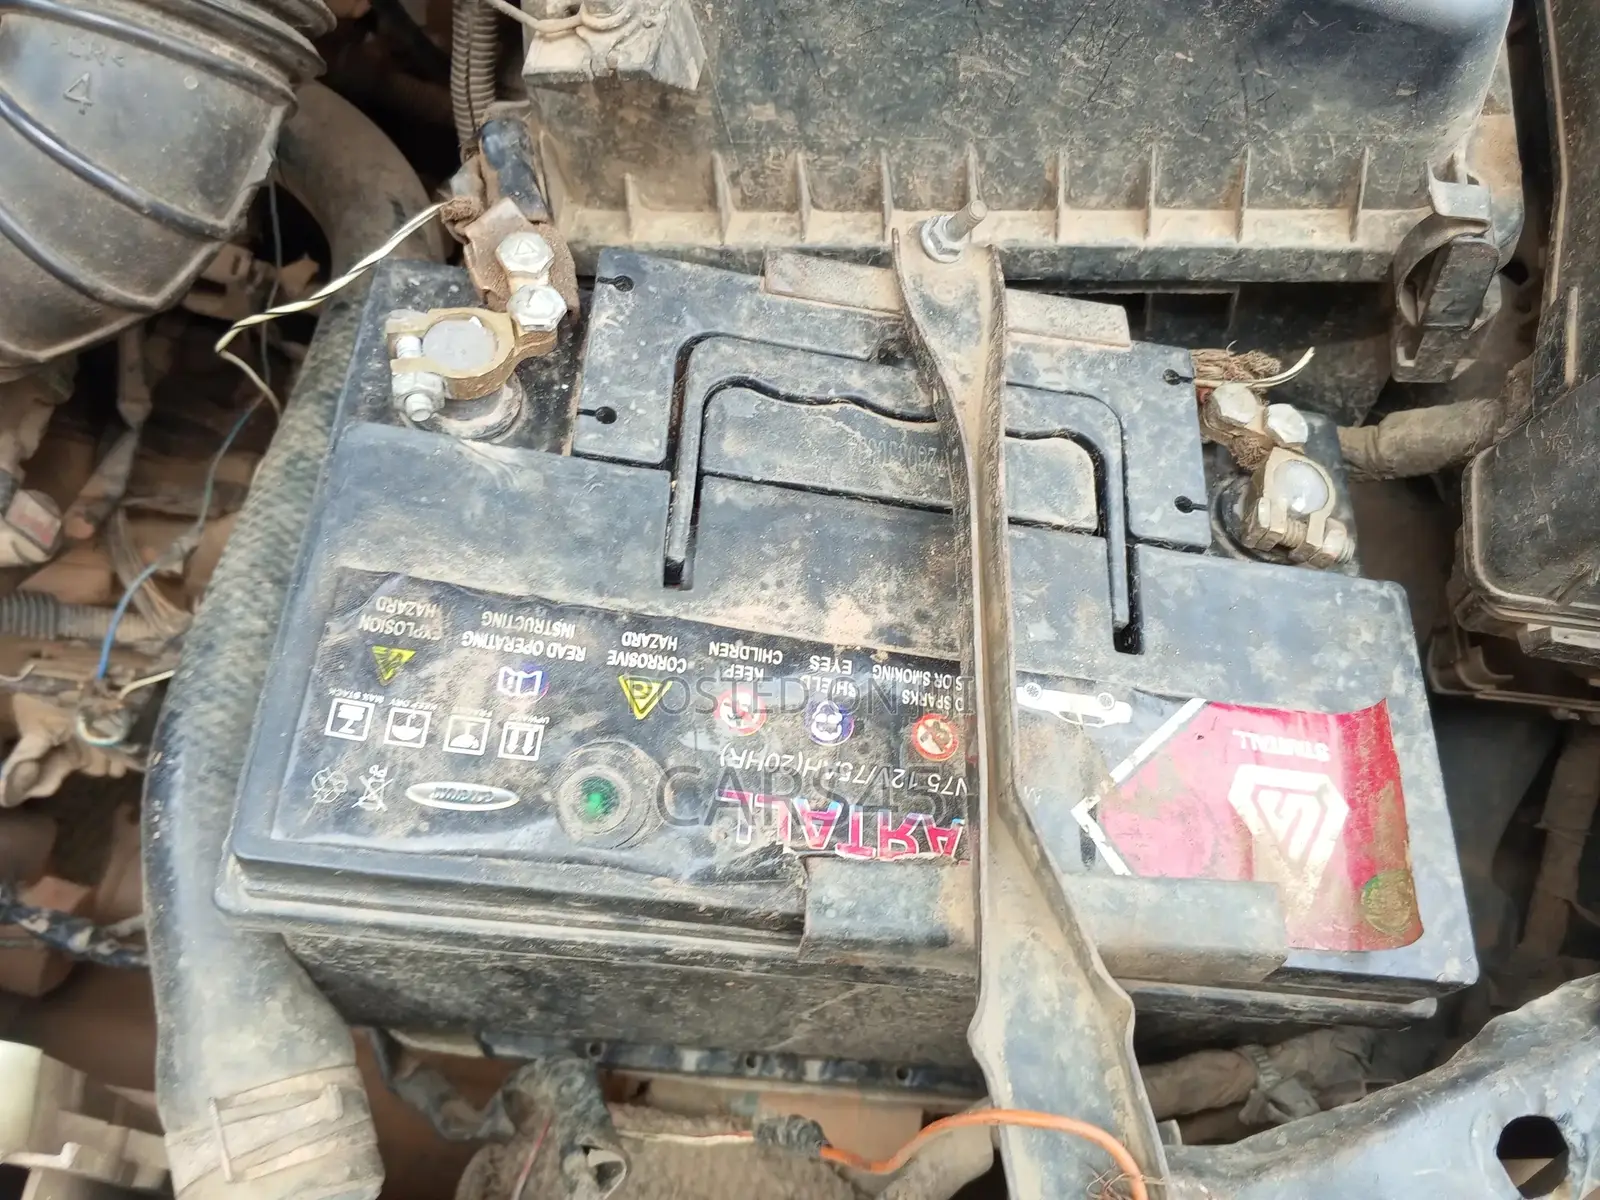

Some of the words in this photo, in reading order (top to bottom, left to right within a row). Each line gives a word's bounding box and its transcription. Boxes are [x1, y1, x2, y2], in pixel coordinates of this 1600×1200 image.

[375, 596, 439, 617] HAZARD
[358, 614, 442, 641] EXPLOSION
[481, 610, 576, 638] INSTRUCTING
[460, 630, 544, 658] OPERATING
[621, 630, 678, 651] HAZARD
[546, 643, 586, 662] READ
[607, 648, 688, 674] CORROSIVE
[708, 641, 783, 664] CHILDREN
[724, 663, 764, 681] KEEP
[809, 654, 853, 675] EYES
[872, 663, 931, 685] SMOKING
[799, 674, 856, 698] SHIELD
[933, 672, 951, 689] OR
[901, 689, 952, 709] SPARKS
[714, 788, 965, 861] ARTALL
